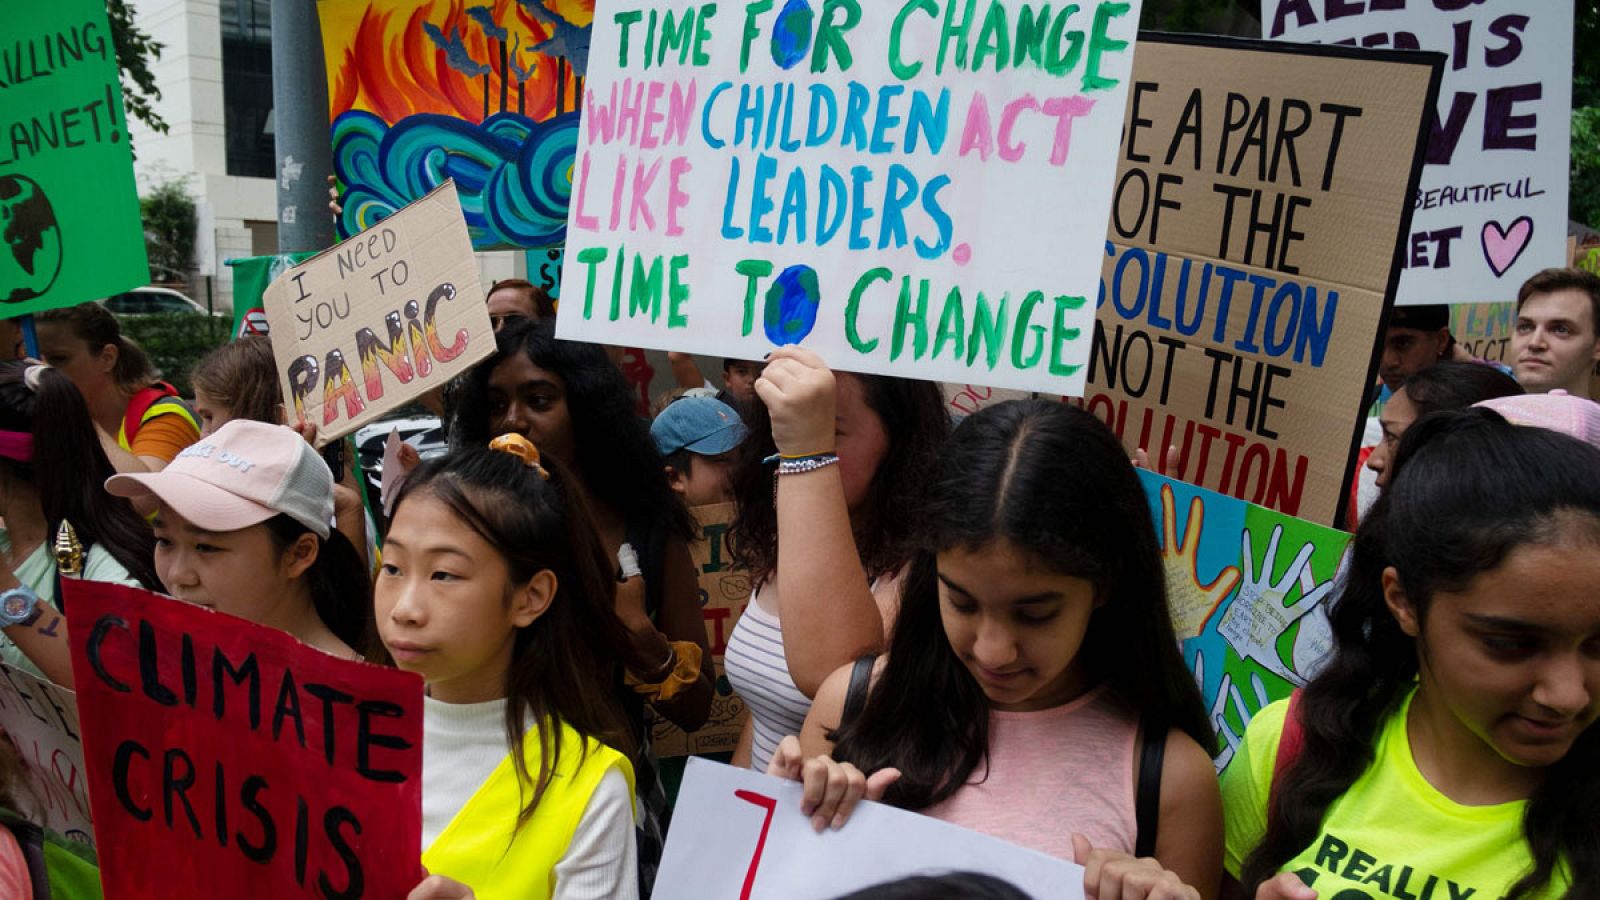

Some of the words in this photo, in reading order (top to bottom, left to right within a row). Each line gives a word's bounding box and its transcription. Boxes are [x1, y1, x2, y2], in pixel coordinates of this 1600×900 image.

[0, 21, 106, 88] ILLING
[615, 2, 716, 68] TIME
[888, 0, 1132, 92] CHANGE
[1452, 14, 1530, 71] IS
[0, 83, 120, 165] ANET!
[586, 77, 697, 147] WHEN
[701, 80, 951, 155] CHILDREN
[958, 91, 1098, 167] ACT
[1120, 81, 1159, 163] E
[1164, 88, 1202, 170] A
[1216, 92, 1363, 191] PART
[1424, 82, 1542, 165] VE
[575, 153, 693, 237] LIKE
[721, 154, 972, 266] LEADERS.
[1113, 168, 1183, 244] OF
[1213, 183, 1312, 275] THE
[1414, 177, 1545, 210] BEAUTIFUL
[292, 271, 312, 304] I
[1403, 226, 1463, 269] ET
[296, 292, 350, 341] YOU
[371, 260, 409, 295] TO
[577, 244, 689, 329] TIME
[844, 267, 1088, 377] CHANGE
[1087, 319, 1186, 406] NOT
[1204, 348, 1292, 440] THE
[1062, 393, 1308, 517] OLLUTION
[87, 614, 413, 784] CLIMATE
[112, 740, 365, 900] CRISIS
[1315, 833, 1477, 900] REALLY
